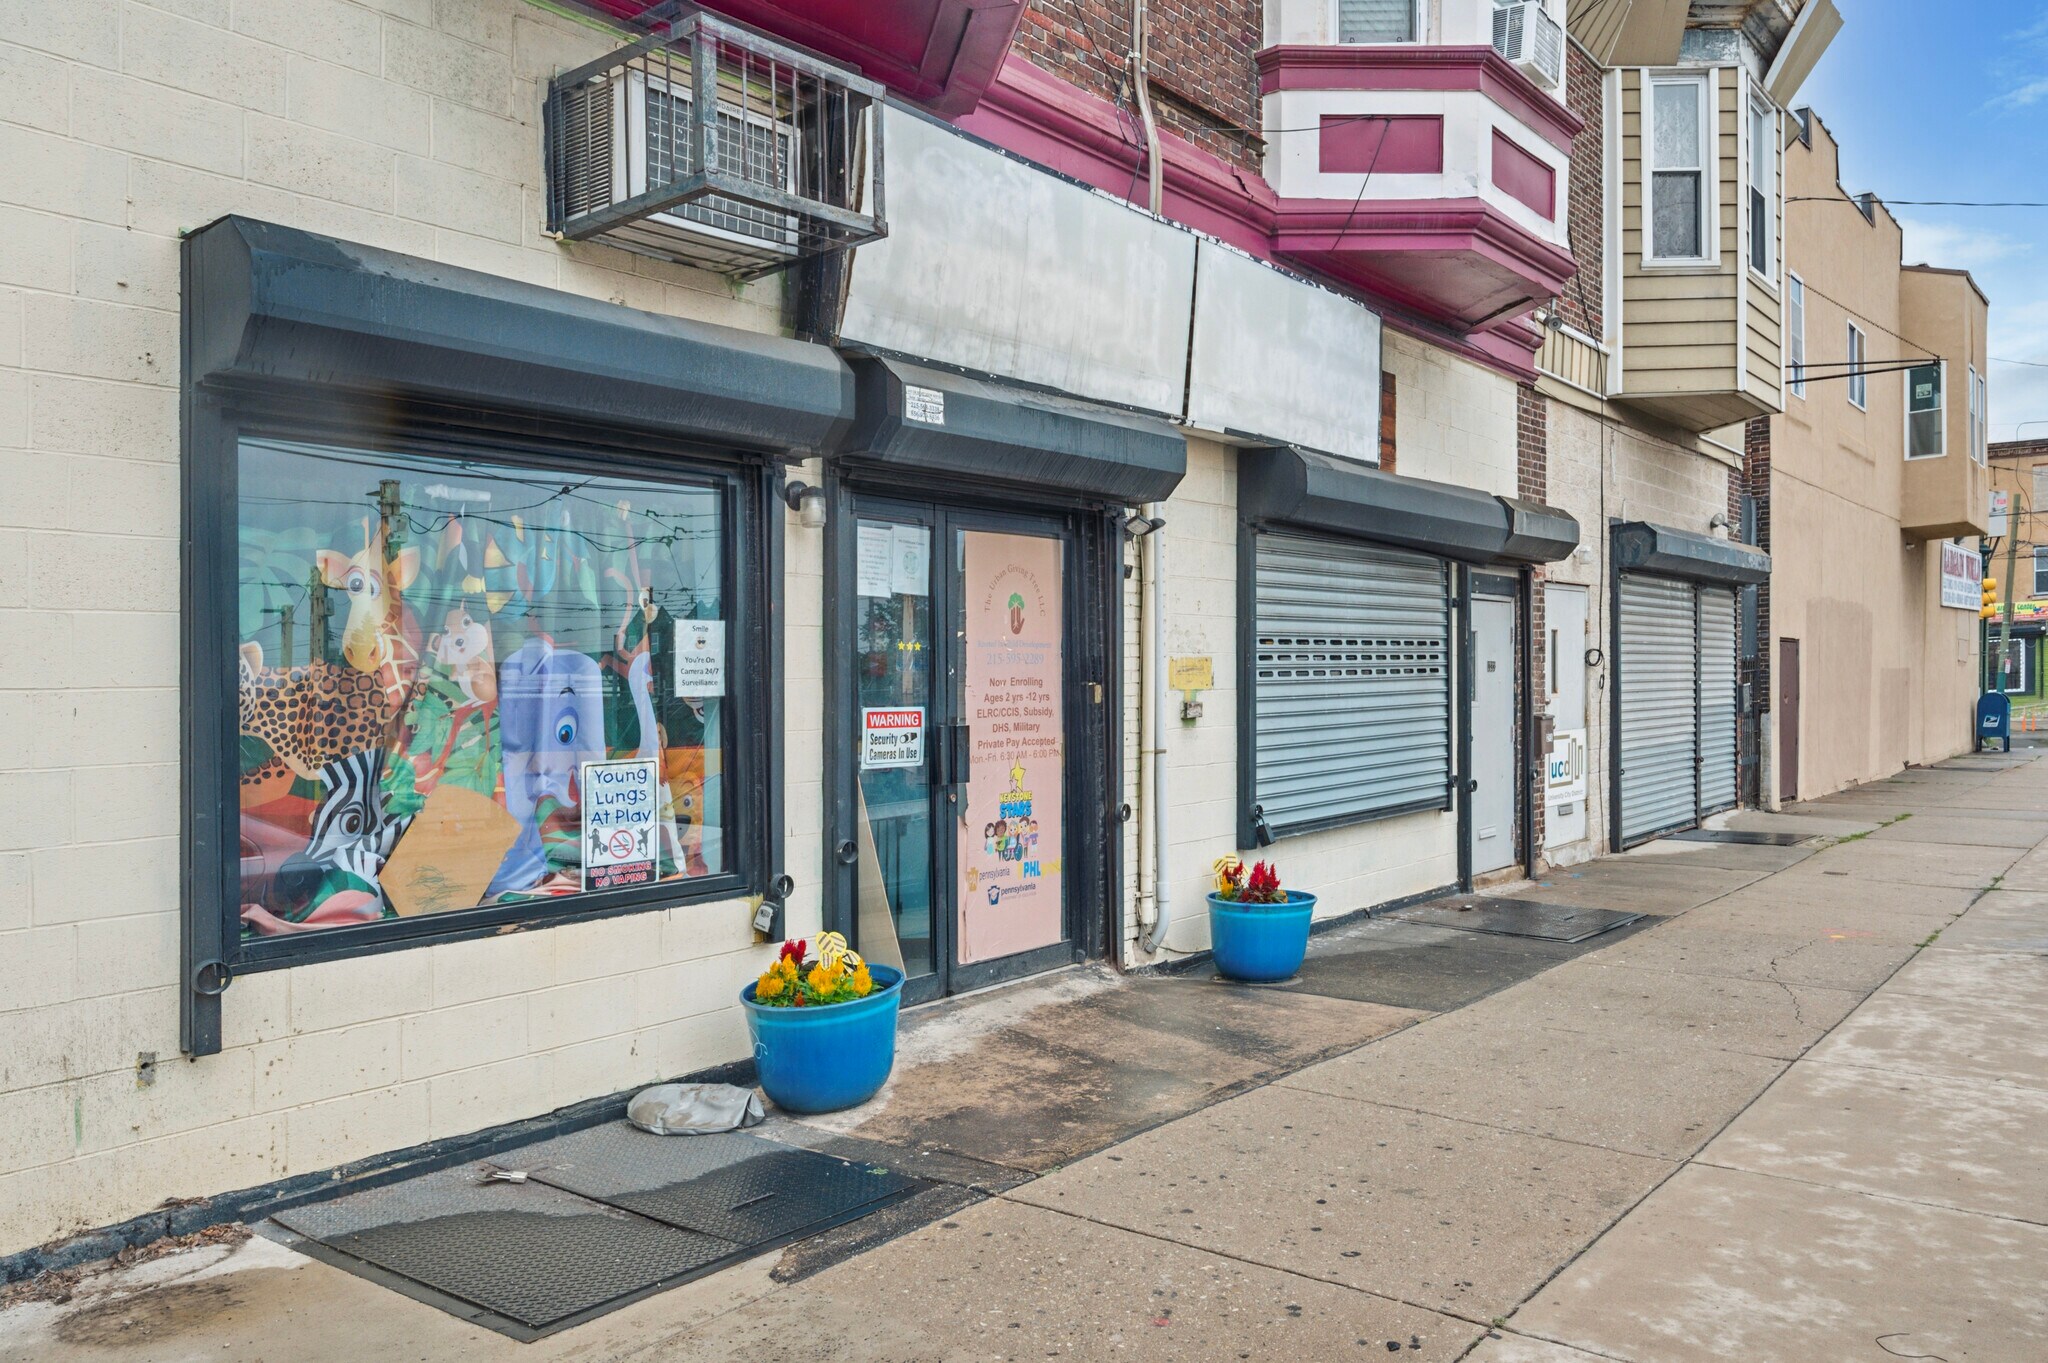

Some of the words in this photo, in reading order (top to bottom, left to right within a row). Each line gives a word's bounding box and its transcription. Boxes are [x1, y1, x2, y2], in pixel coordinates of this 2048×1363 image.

[989, 569, 1007, 591] Urban
[1007, 563, 1029, 579] Giving
[1027, 572, 1041, 593] Tree
[1038, 595, 1046, 618] LLC
[692, 625, 709, 633] Smile
[684, 656, 705, 664] You're
[705, 656, 716, 664] On
[680, 667, 704, 675] Camera
[704, 667, 719, 676] 24/7
[681, 679, 719, 687] Surveillance
[989, 677, 1007, 688] Now
[1010, 676, 1043, 689] Enrolling
[983, 693, 1004, 704] Ages
[1005, 692, 1010, 702] 2
[1011, 694, 1024, 704] yrs
[1038, 693, 1050, 704] yrs
[869, 713, 919, 727] WARNING
[992, 722, 1012, 734] DHS,
[1013, 721, 1040, 733] Military
[870, 732, 898, 747] Security
[977, 739, 1004, 749] Private
[1006, 737, 1020, 749] Pay
[1021, 736, 1056, 747] Accepted
[869, 748, 897, 761] Cameras
[898, 747, 905, 759] In
[905, 747, 918, 759] Use
[1000, 751, 1015, 761] 6:30
[1016, 750, 1028, 760] AM
[1033, 749, 1047, 759] 6:00
[594, 768, 648, 785] Young
[595, 789, 647, 806] Lungs
[999, 791, 1032, 803] KEYSTONE
[999, 800, 1032, 819] STARS
[590, 810, 611, 826] At
[615, 808, 652, 824] Play
[590, 867, 606, 878] NO
[607, 861, 652, 876] SMOKING
[979, 867, 1010, 881] pennsylvania
[1023, 860, 1042, 878] PHL
[595, 876, 610, 888] NO
[612, 871, 648, 885] VAPING
[1001, 882, 1036, 896] pennsylvania
